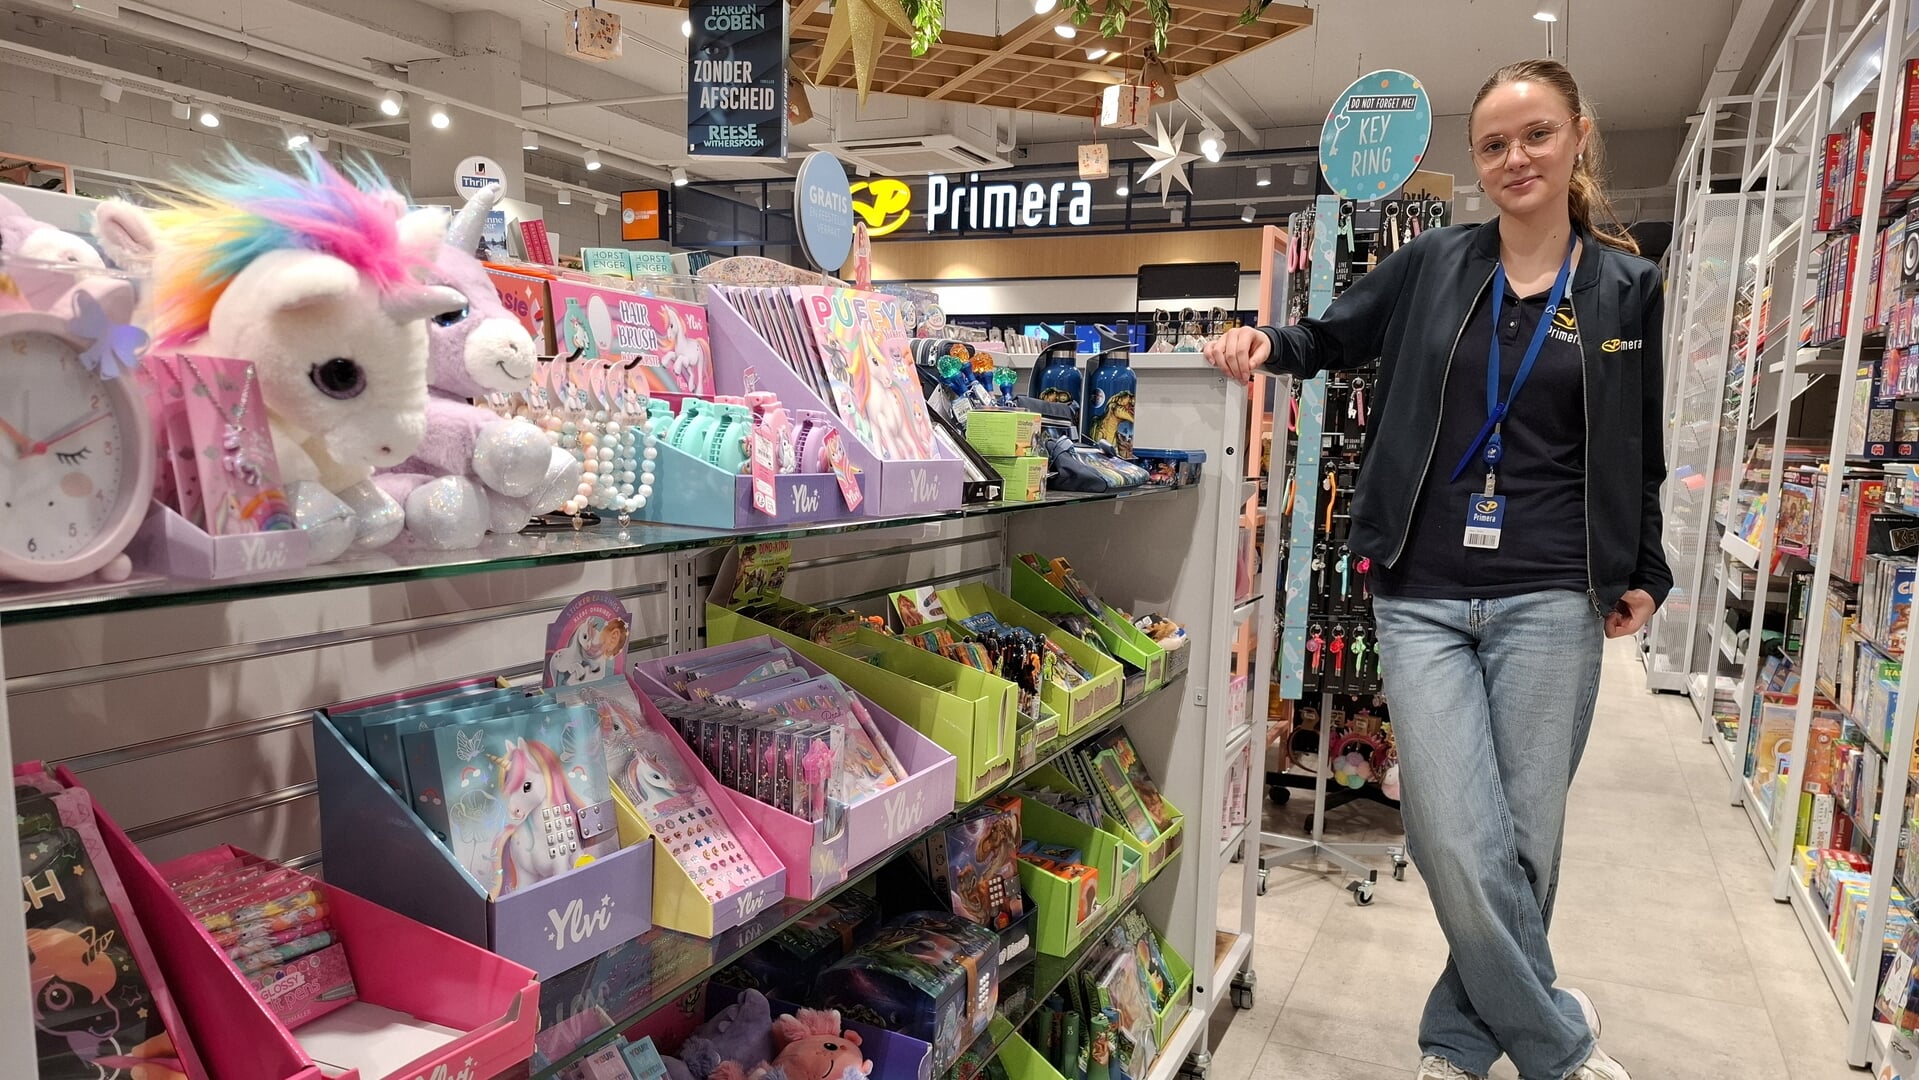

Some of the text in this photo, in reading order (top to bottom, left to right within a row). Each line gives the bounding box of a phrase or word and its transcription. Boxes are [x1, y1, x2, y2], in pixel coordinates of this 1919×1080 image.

[711, 4, 757, 15] HARLAN
[704, 14, 765, 30] COBEN
[693, 60, 753, 83] ZONDER
[700, 86, 775, 111] AFSCHEID
[1351, 97, 1415, 109] DO NOT FORGET ME!
[709, 124, 758, 140] REESE
[1359, 113, 1392, 145] KEY
[703, 139, 764, 148] WITHERSPOON
[1351, 146, 1392, 177] RING
[809, 185, 848, 214] GRATIS
[927, 173, 1093, 232] Primera
[591, 251, 625, 260] HORST
[593, 260, 626, 269] ENGER
[635, 255, 666, 263] HORST
[636, 263, 668, 272] ENGER
[619, 300, 650, 327] HAIR
[685, 313, 703, 331] Ylvi
[811, 295, 898, 331] PUFFY
[617, 324, 659, 352] BRUSH
[1548, 325, 1580, 345] Primer
[910, 467, 940, 504] Ylvi
[791, 483, 820, 514] Ylvi
[1473, 512, 1497, 523] Primera
[68, 523, 78, 538] 5
[26, 538, 38, 553] 6
[240, 538, 289, 571] Ylvi
[883, 788, 925, 840] Ylvi
[736, 889, 765, 919] Ylvi
[547, 893, 612, 951] Ylvi
[260, 974, 300, 1000] GLOSSY
[285, 978, 321, 1010] pens
[593, 1050, 616, 1065] YOUR
